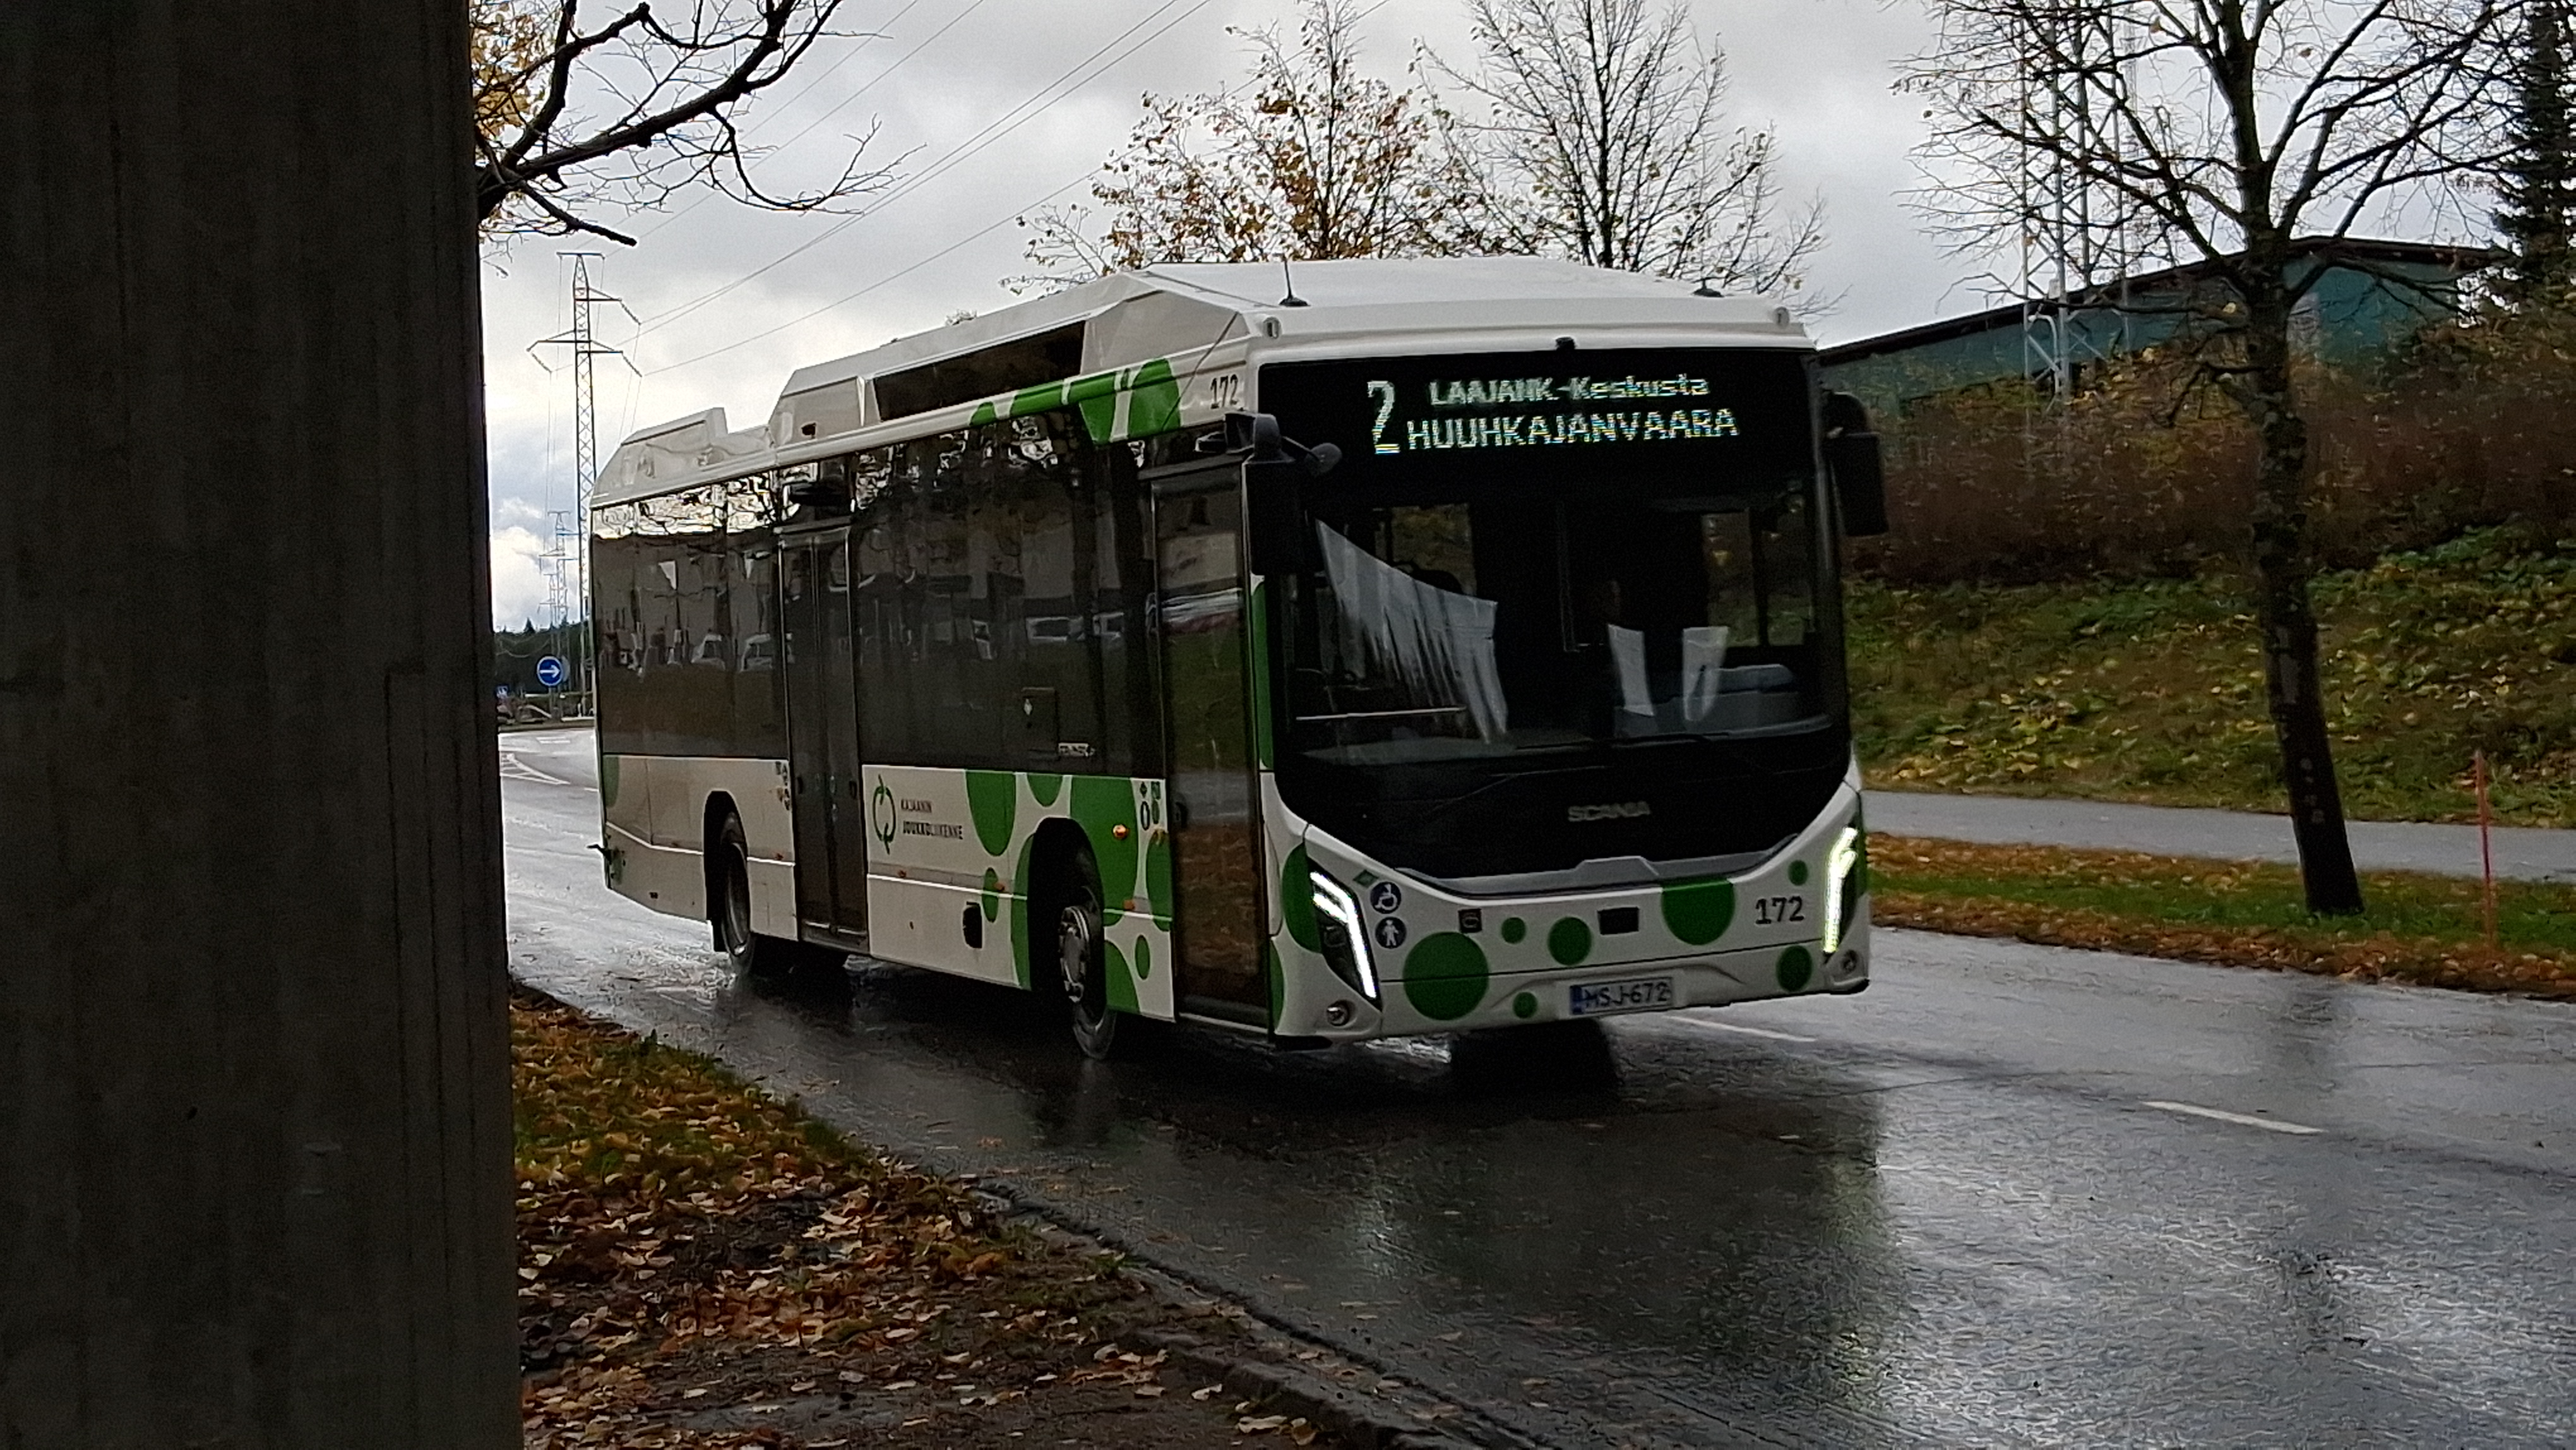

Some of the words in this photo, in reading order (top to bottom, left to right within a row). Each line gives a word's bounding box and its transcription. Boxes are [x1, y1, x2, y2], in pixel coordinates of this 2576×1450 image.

[1210, 374, 1239, 409] 172
[1368, 380, 1400, 454] 2
[1407, 408, 1739, 450] HUUHKAJANVAARA
[1568, 801, 1651, 822] SCANIA
[1755, 895, 1804, 925] 172
